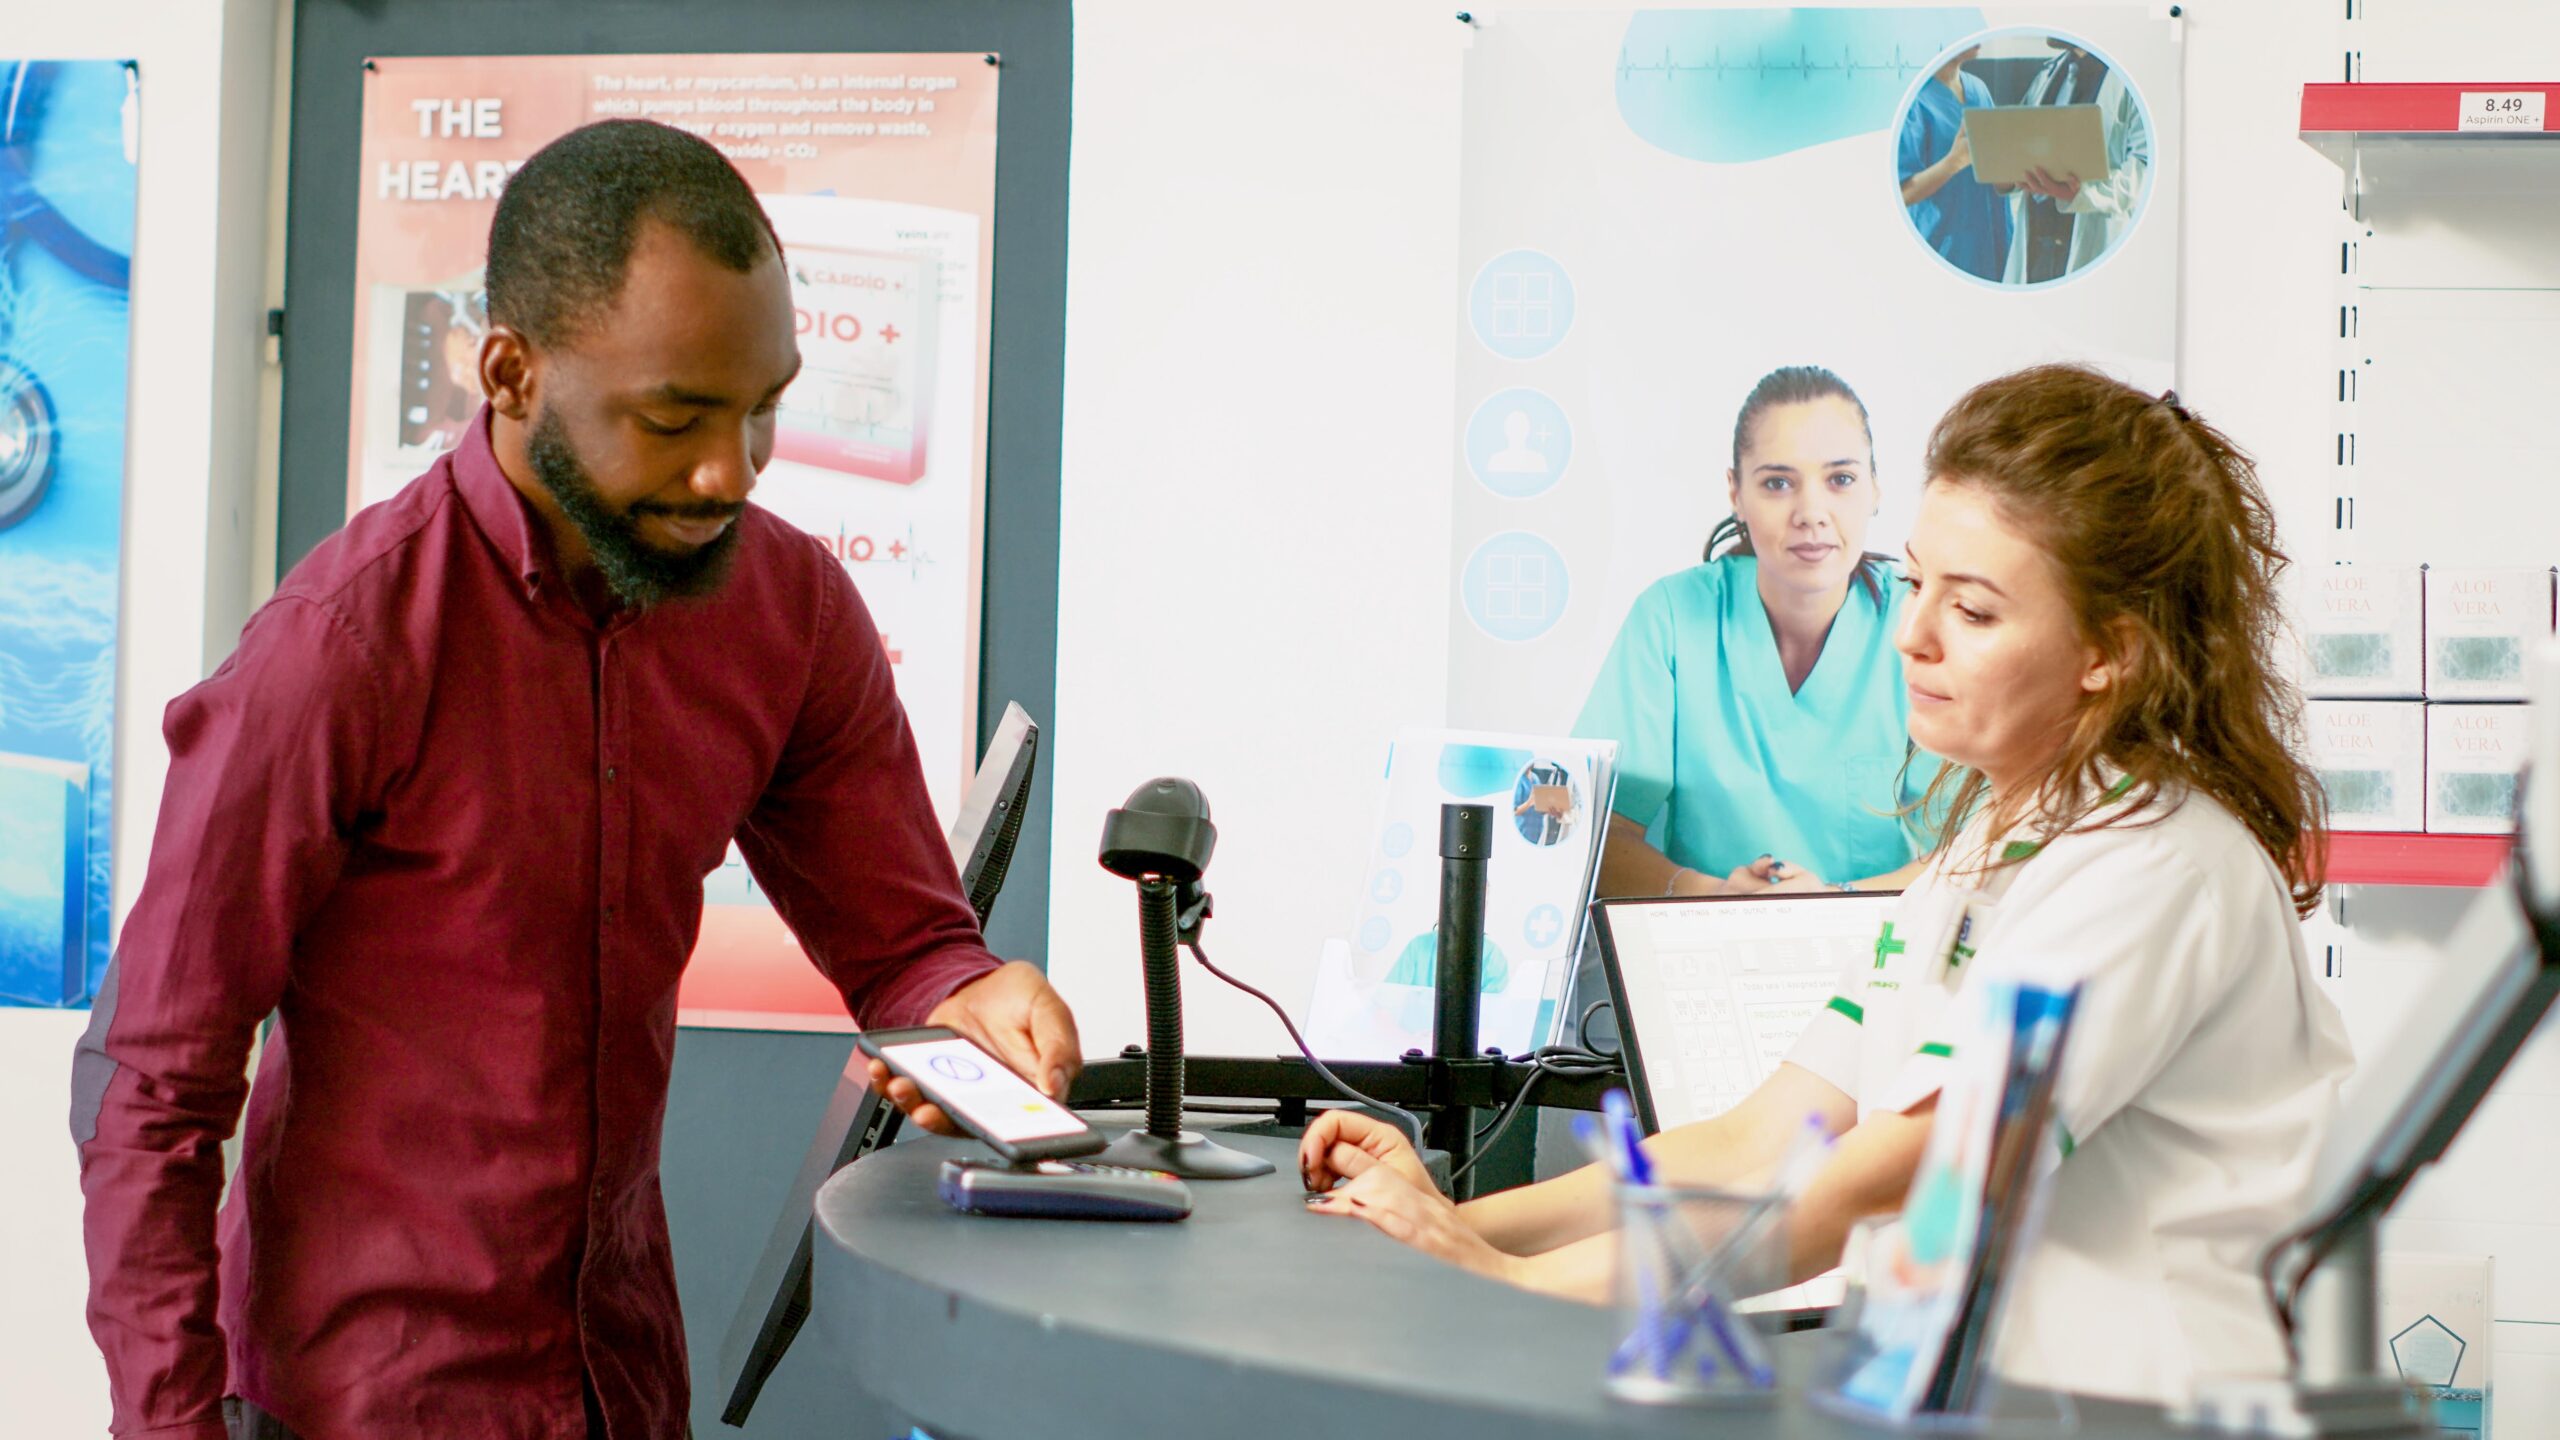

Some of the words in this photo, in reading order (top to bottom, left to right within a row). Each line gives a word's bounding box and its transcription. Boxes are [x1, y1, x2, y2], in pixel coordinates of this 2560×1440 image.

[593, 75, 623, 90] The
[625, 75, 672, 92] heart,
[673, 78, 692, 90] or
[696, 75, 798, 93] myocardium,
[801, 75, 816, 90] is
[818, 77, 840, 90] an
[842, 74, 905, 90] internal
[908, 76, 957, 92] organ
[593, 98, 639, 113] which
[641, 101, 695, 116] pumps
[697, 97, 745, 113] blood
[747, 97, 839, 115] throughout
[841, 97, 869, 113] the
[871, 97, 915, 115] body
[917, 97, 935, 113] in
[2485, 98, 2522, 112] 8.49
[411, 98, 503, 139] THE
[2465, 115, 2503, 125] Aspirin
[2507, 115, 2530, 124] ONE
[716, 122, 776, 139] oxygen
[779, 120, 811, 136] and
[814, 122, 876, 136] remove
[878, 121, 931, 137] waste,
[896, 229, 928, 240] Veins
[815, 270, 886, 290] CARDIO
[2321, 577, 2369, 592] ALOE
[2450, 580, 2497, 594] ALOE
[2323, 599, 2372, 613] VERA
[2452, 601, 2502, 615] VERA
[2325, 713, 2371, 728] ALOE
[2452, 716, 2500, 730] ALOE
[2327, 735, 2375, 749] VERA
[2454, 737, 2503, 752] VERA
[1649, 910, 1668, 918] HOME
[1680, 909, 1710, 918] SETTINGS
[1743, 907, 1767, 915] OUTPUT
[1752, 1010, 1788, 1018] PRODUCT
[1791, 1008, 1813, 1017] NAME
